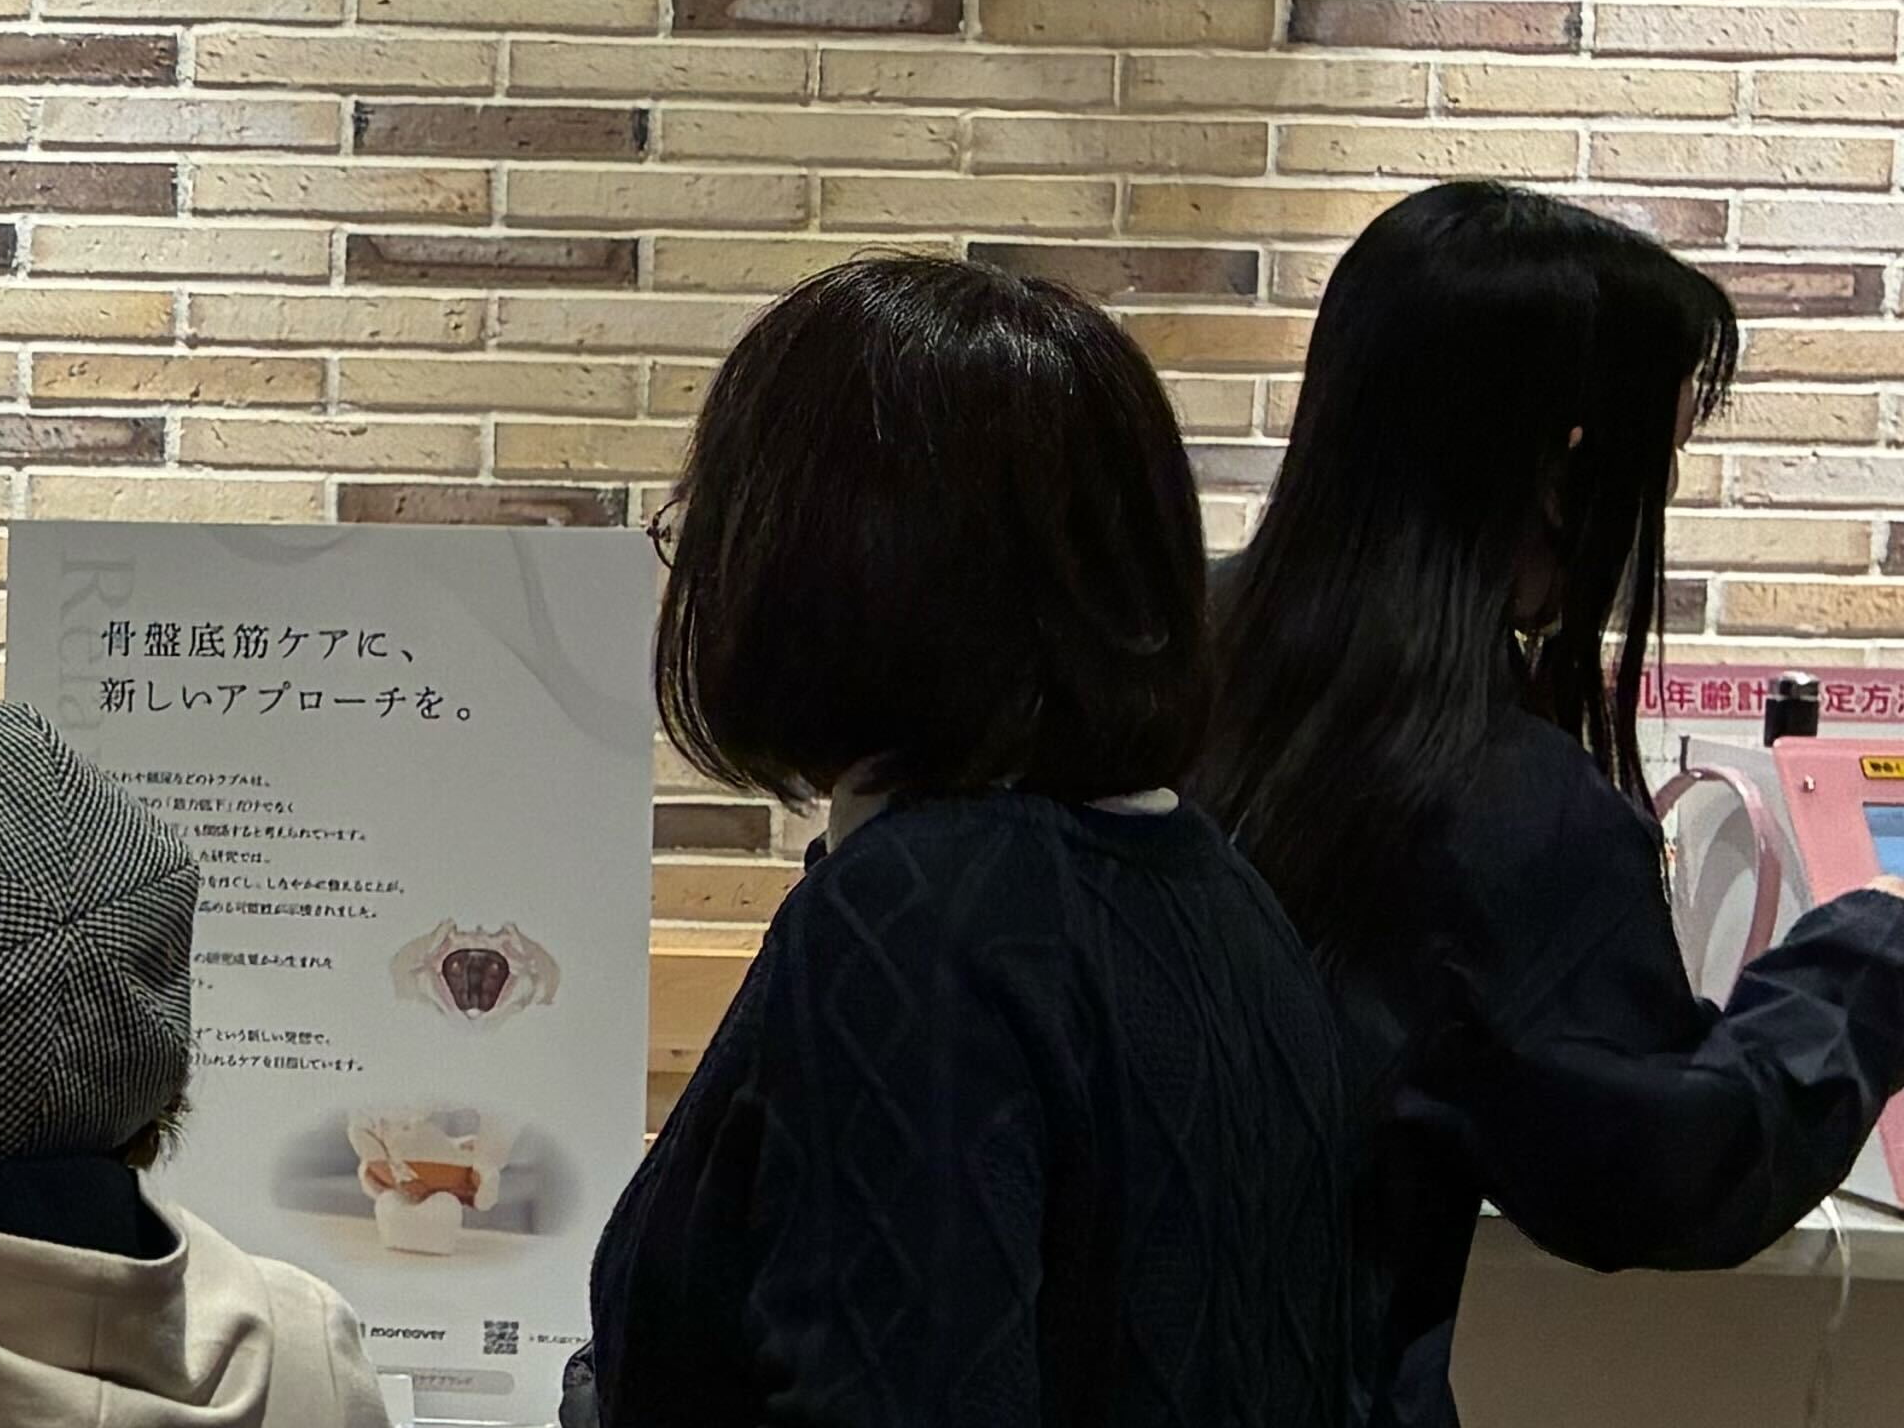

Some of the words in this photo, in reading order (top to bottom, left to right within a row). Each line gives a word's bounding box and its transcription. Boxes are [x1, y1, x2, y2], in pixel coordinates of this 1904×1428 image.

[100, 620, 415, 663] 骨盤底筋ケアに、
[99, 677, 471, 723] 新しいアプローチを。
